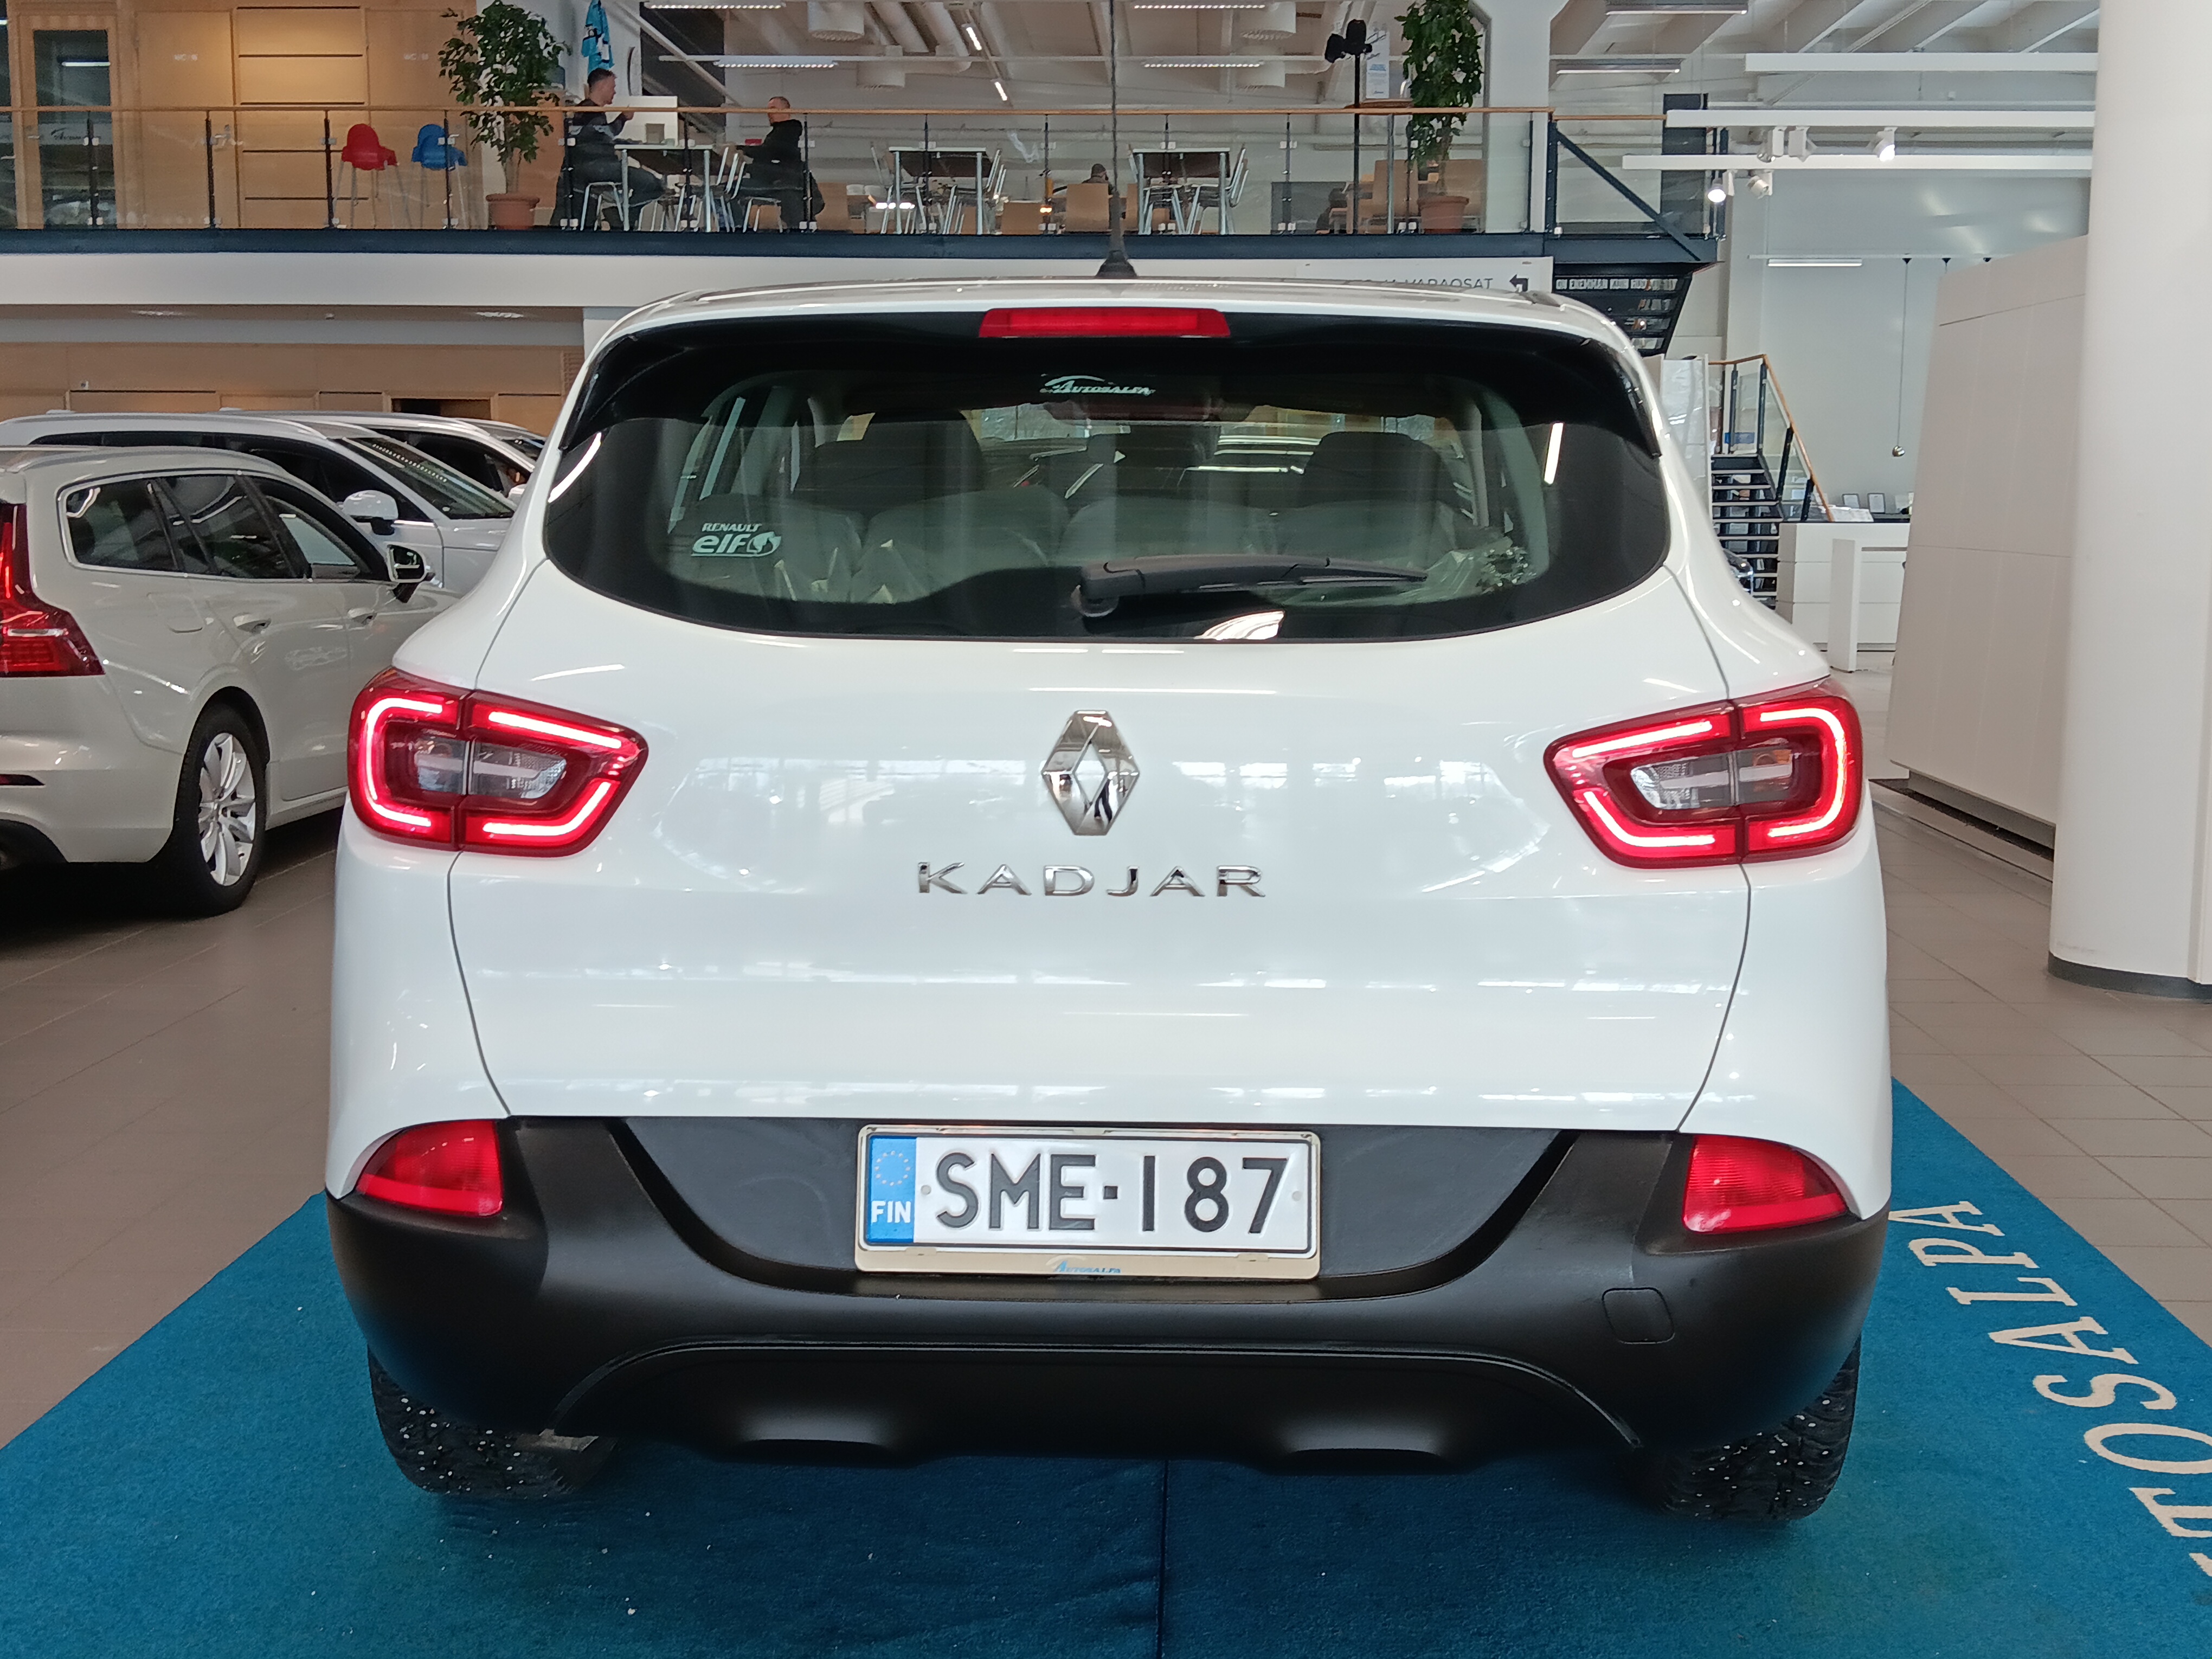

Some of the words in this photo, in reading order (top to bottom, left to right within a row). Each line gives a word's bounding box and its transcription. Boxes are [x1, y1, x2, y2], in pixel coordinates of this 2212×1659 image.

[702, 523, 762, 532] RENAULT
[692, 533, 751, 553] elf
[917, 861, 1266, 898] KADJAR
[936, 1152, 1289, 1234] SME-187
[871, 1200, 911, 1223] FIN
[1888, 1201, 2212, 1577] TOSALPA
